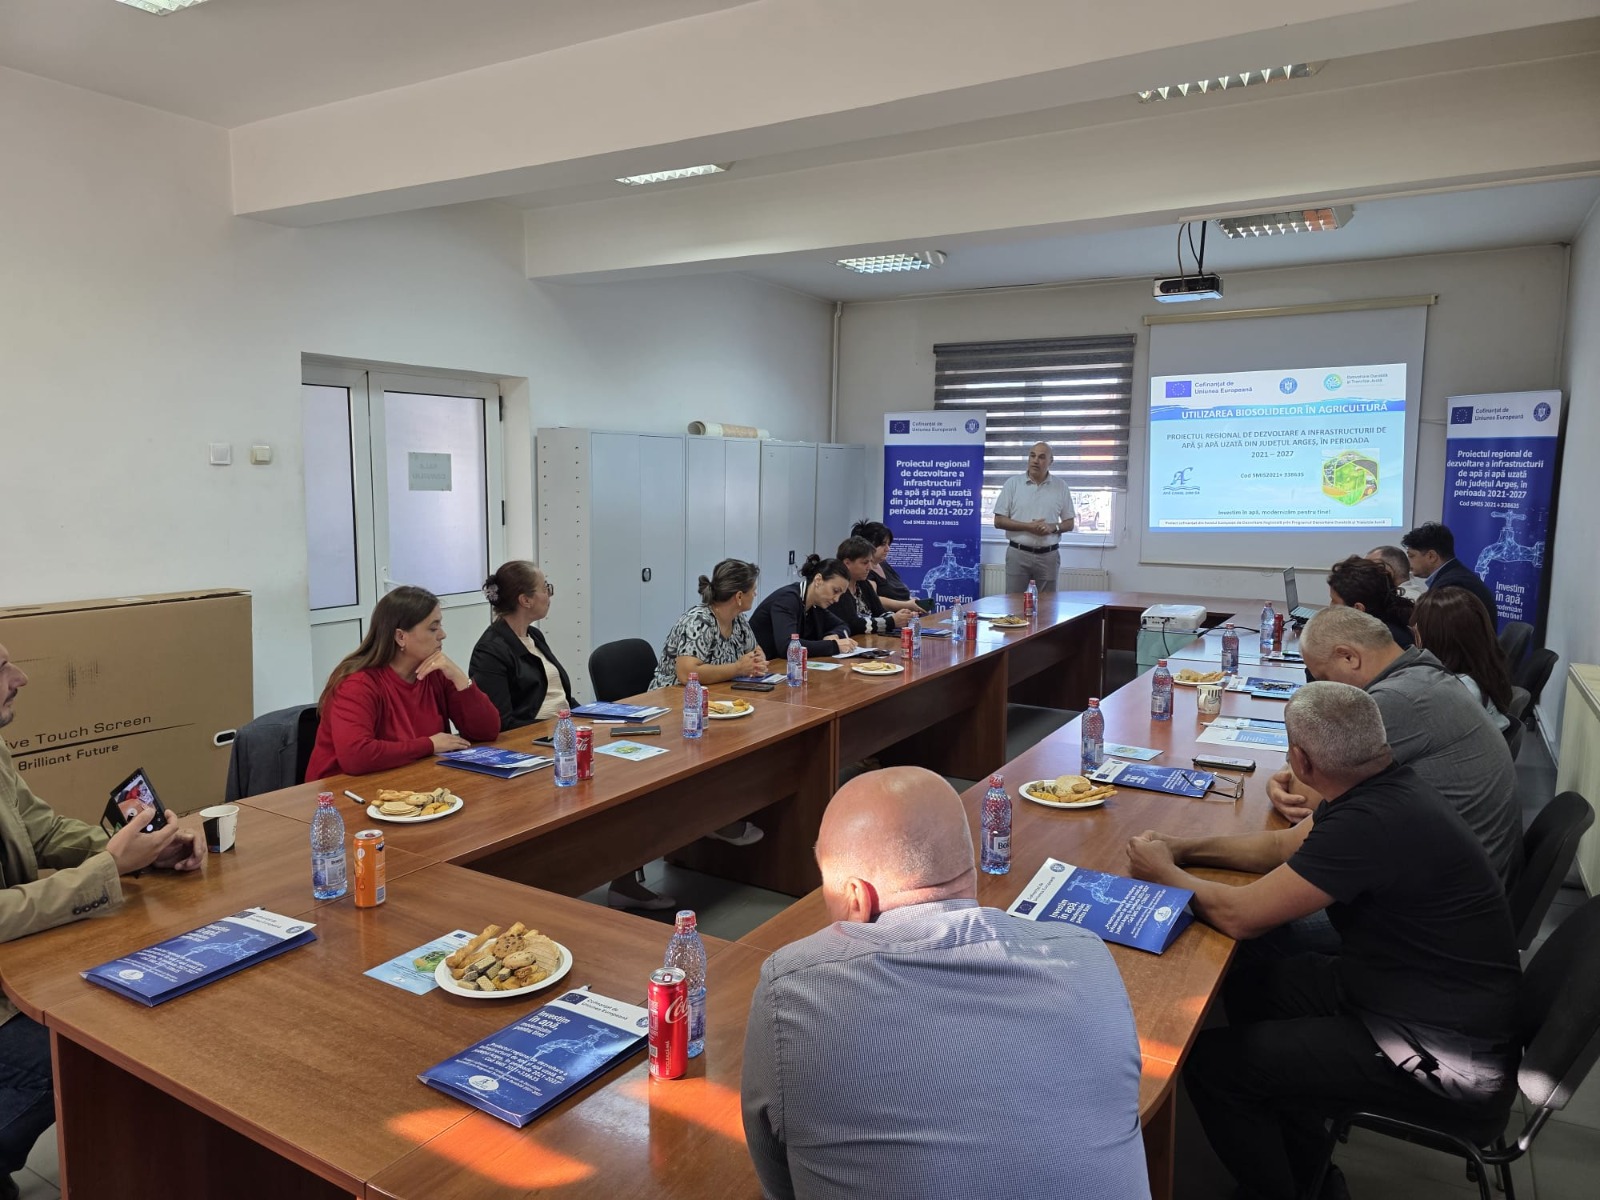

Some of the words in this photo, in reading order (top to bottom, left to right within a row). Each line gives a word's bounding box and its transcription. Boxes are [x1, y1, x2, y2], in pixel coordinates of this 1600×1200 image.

[1181, 408, 1234, 419] UTILIZAREA
[1235, 405, 1303, 417] BIOSOLIDELOR
[1305, 404, 1316, 414] ÎN
[1205, 432, 1241, 440] REGIONAL
[1253, 429, 1299, 438] DEZVOLTARE
[1307, 427, 1375, 436] INFRASTRUCTURII
[1376, 426, 1387, 434] DE
[1181, 441, 1196, 449] APĂ
[1204, 440, 1219, 448] APĂ
[1220, 440, 1243, 448] UZATĂ
[1258, 439, 1291, 448] JUDEȚUL
[1292, 438, 1319, 447] ARGEȘ,
[1320, 437, 1329, 445] ÎN
[1330, 437, 1370, 445] PERIOADA
[1276, 450, 1294, 458] 2027
[1457, 450, 1490, 458] Proiectul
[1491, 450, 1522, 459] regional
[1523, 450, 1533, 458] de
[896, 460, 933, 468] Proiectul
[935, 460, 971, 469] regional
[1446, 459, 1485, 468] dezvoltare
[1491, 459, 1544, 468] infrastructurii
[900, 469, 911, 477] de
[912, 469, 958, 477] dezvoltare
[1458, 469, 1468, 477] de
[1468, 469, 1483, 479] apă
[1484, 470, 1491, 479] și
[1491, 469, 1506, 479] apă
[1507, 470, 1528, 478] uzată
[903, 478, 962, 487] infrastructurii
[1455, 479, 1468, 487] din
[1468, 479, 1495, 489] județul
[892, 488, 903, 496] de
[904, 488, 920, 497] apă
[921, 489, 929, 498] și
[933, 489, 946, 498] apă
[948, 489, 972, 497] uzată
[1454, 489, 1486, 498] perioada
[1487, 489, 1527, 499] 2021-2027
[889, 497, 903, 505] din
[904, 498, 935, 507] județul
[936, 498, 963, 507] Argeș,
[965, 498, 974, 506] în
[889, 507, 926, 516] perioada
[927, 508, 974, 516] 2021-2027
[1496, 581, 1525, 594] Investim
[1495, 590, 1504, 601] în
[1505, 593, 1524, 606] apă,
[35, 726, 89, 745] Touch
[94, 715, 152, 734] Screen
[18, 752, 71, 771] Brilliant
[76, 743, 119, 760] Future
[540, 1010, 571, 1024] Investim
